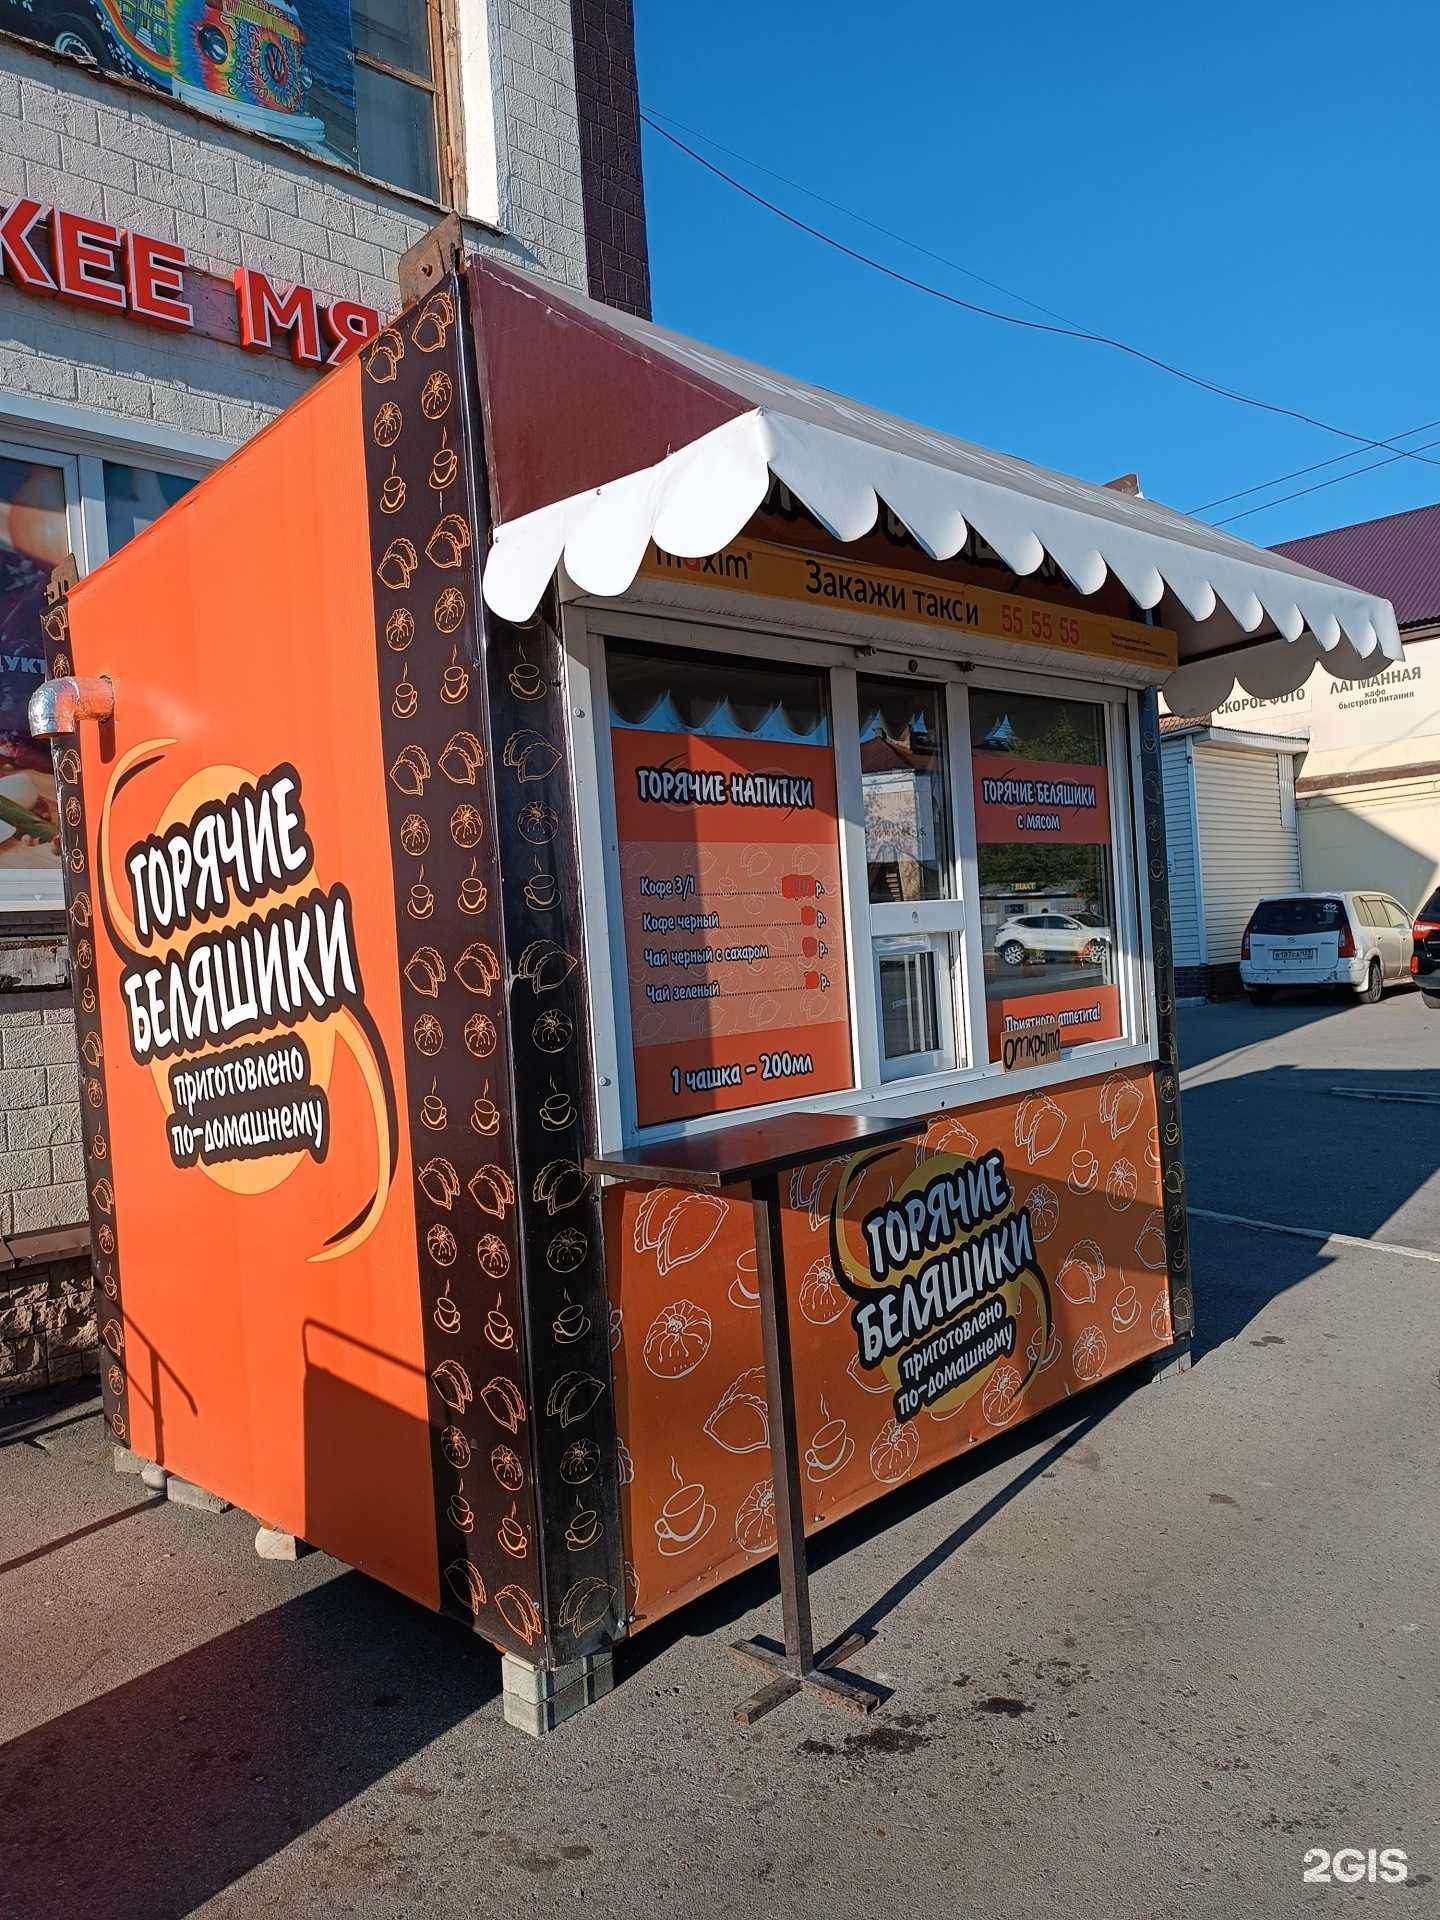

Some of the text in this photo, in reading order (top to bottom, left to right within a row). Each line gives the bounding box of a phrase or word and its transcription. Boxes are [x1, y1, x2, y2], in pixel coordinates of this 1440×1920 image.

[805, 559, 906, 611] Закажи
[912, 590, 979, 625] такси
[1002, 604, 1024, 634] 55
[1032, 610, 1053, 641] 55
[1060, 616, 1080, 645] 55
[1216, 697, 1266, 715] СКОРОЕ
[1338, 691, 1415, 710] быстрого питания
[638, 770, 813, 807] ГОРЯЧИЕ НАПИТКИ
[983, 780, 1096, 807] ГОРЯЧИЕ БЕЛЯШИКИ
[130, 777, 307, 936] ГОРЯЧИЕ
[640, 878, 672, 898] Кофе
[675, 876, 695, 900] 3/1
[643, 914, 674, 934] Кофе
[677, 912, 719, 933] черный
[124, 897, 357, 1054] БЕЛЯШИКИ
[644, 949, 668, 967] Чай
[671, 948, 713, 968] черный
[715, 950, 722, 961] с
[725, 945, 769, 965] сахаром
[646, 984, 670, 1003] Чай
[673, 981, 720, 1000] зеленый
[174, 1045, 304, 1115] приготовлено
[672, 1068, 680, 1093] 1
[686, 1063, 741, 1090] чашка
[760, 1053, 813, 1080] 200мл
[172, 1098, 323, 1156] по-домашнему
[867, 1156, 1007, 1273] ГОРЯЧИЕ
[857, 1213, 1033, 1361] БЕЛЯШИКИ
[903, 1301, 1002, 1380] приготовлено
[898, 1323, 1013, 1415] по-домашнему
